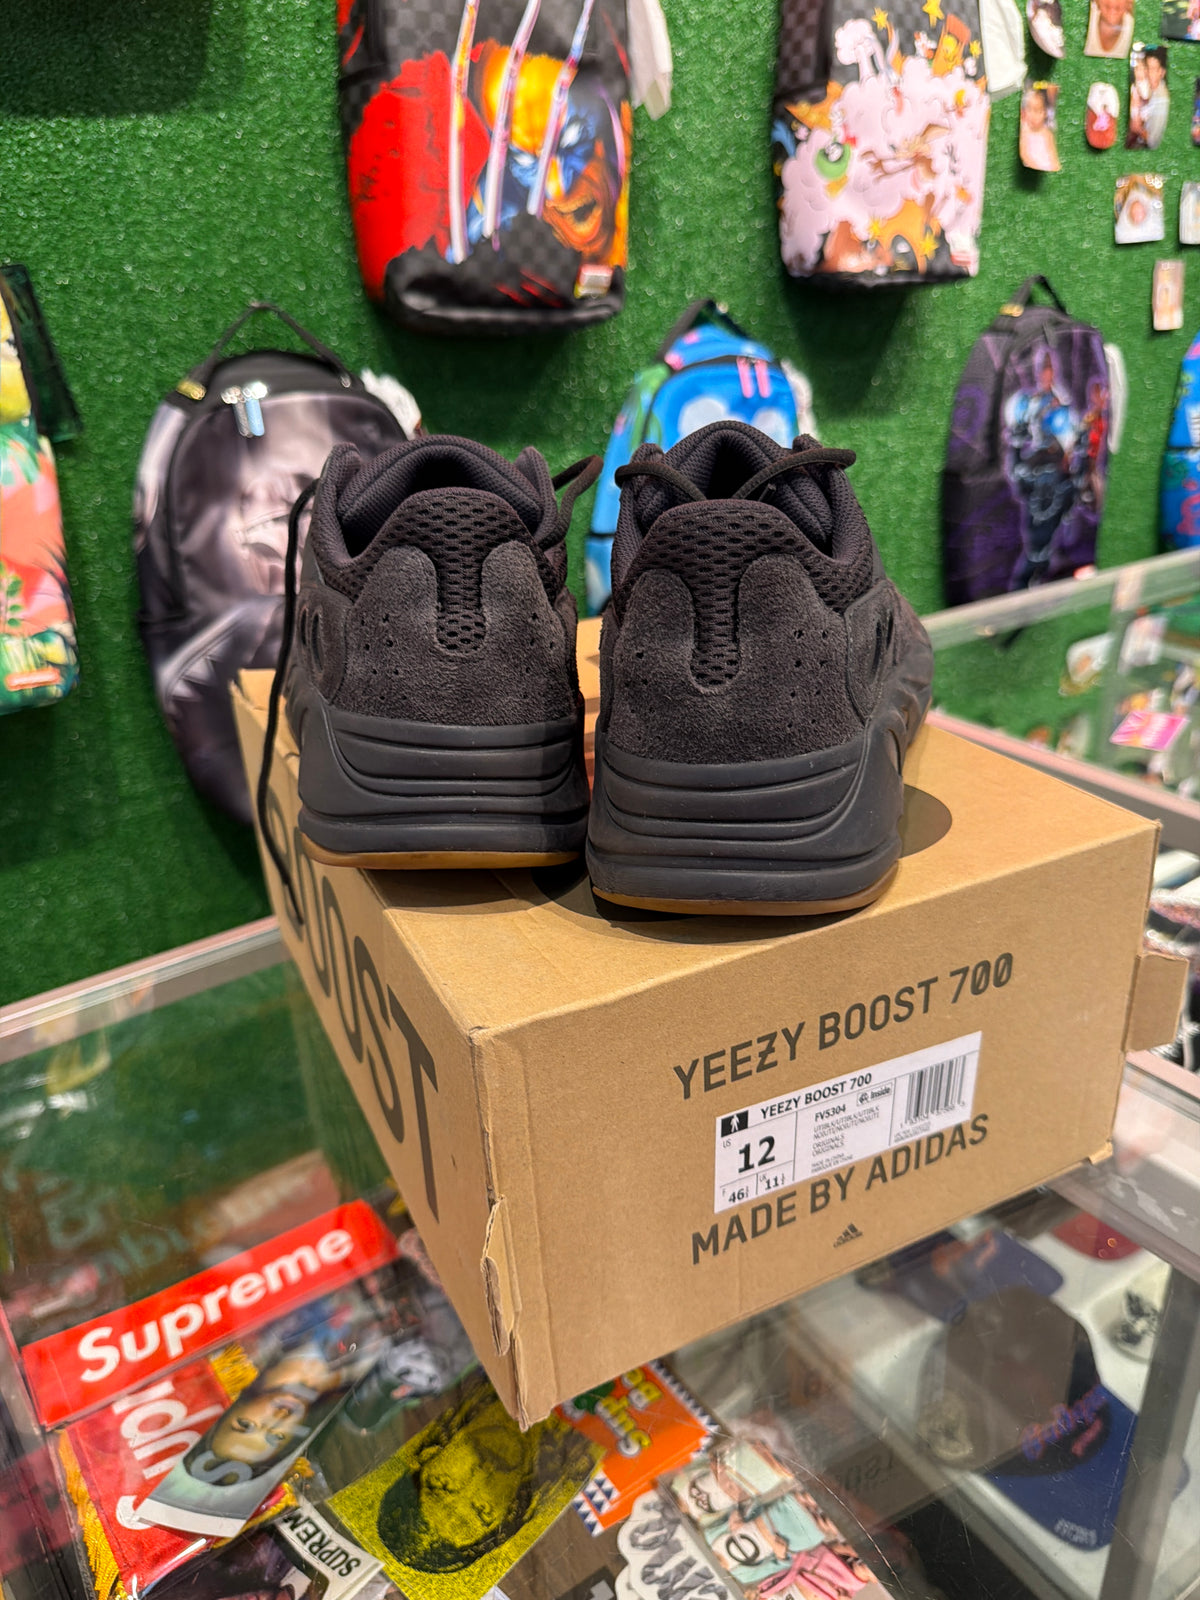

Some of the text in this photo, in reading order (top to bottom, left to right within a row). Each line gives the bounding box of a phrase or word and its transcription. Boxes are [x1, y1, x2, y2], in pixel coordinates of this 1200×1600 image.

[673, 952, 1014, 1100] YEEZY BOOST 700
[760, 1072, 872, 1120] YEEZY BOOST 700
[814, 1104, 847, 1122] FV5304
[691, 1113, 988, 1265] MADE BY ADIDAS
[738, 1135, 775, 1174] 12
[78, 1229, 353, 1383] Supreme
